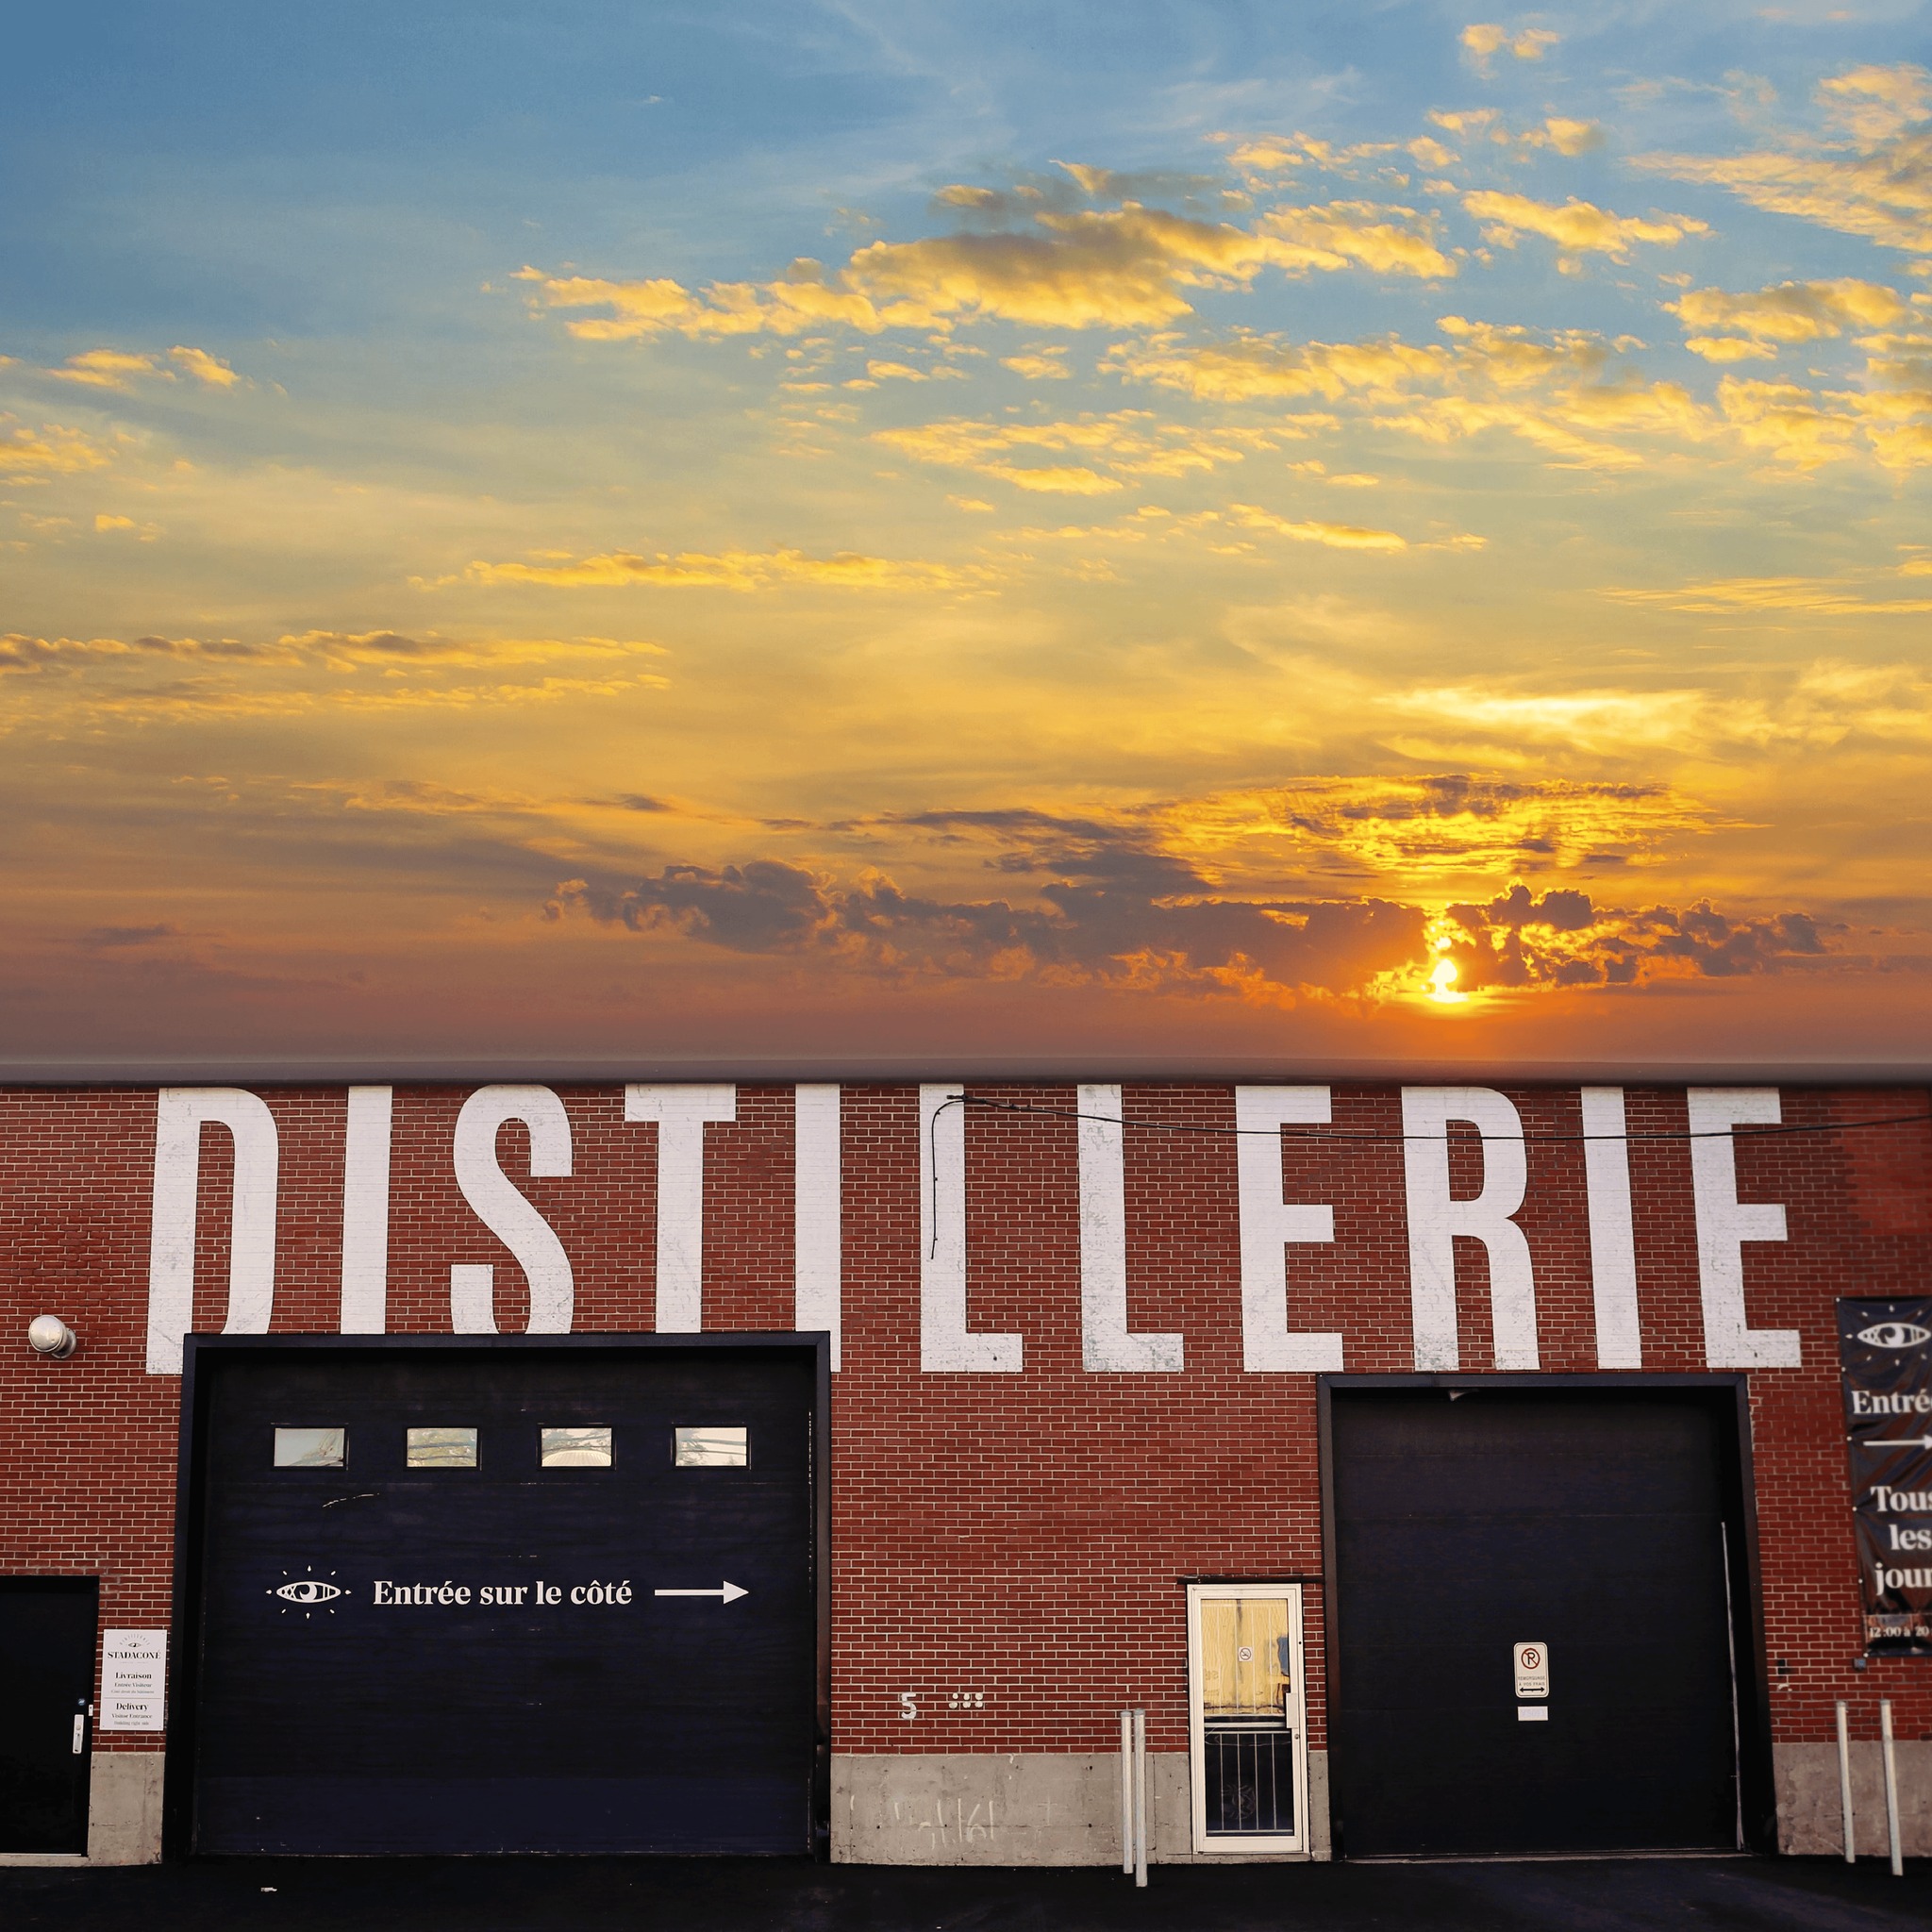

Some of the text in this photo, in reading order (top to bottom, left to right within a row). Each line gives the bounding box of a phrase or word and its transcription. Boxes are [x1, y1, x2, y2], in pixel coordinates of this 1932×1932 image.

[145, 1084, 1802, 1374] DISTILLERIE
[1851, 1389, 1932, 1414] Entré
[1889, 1524, 1932, 1550] les
[373, 1579, 633, 1606] Entrée sur le côté
[107, 1649, 161, 1659] STADACONÉ
[116, 1702, 148, 1711] Delivery
